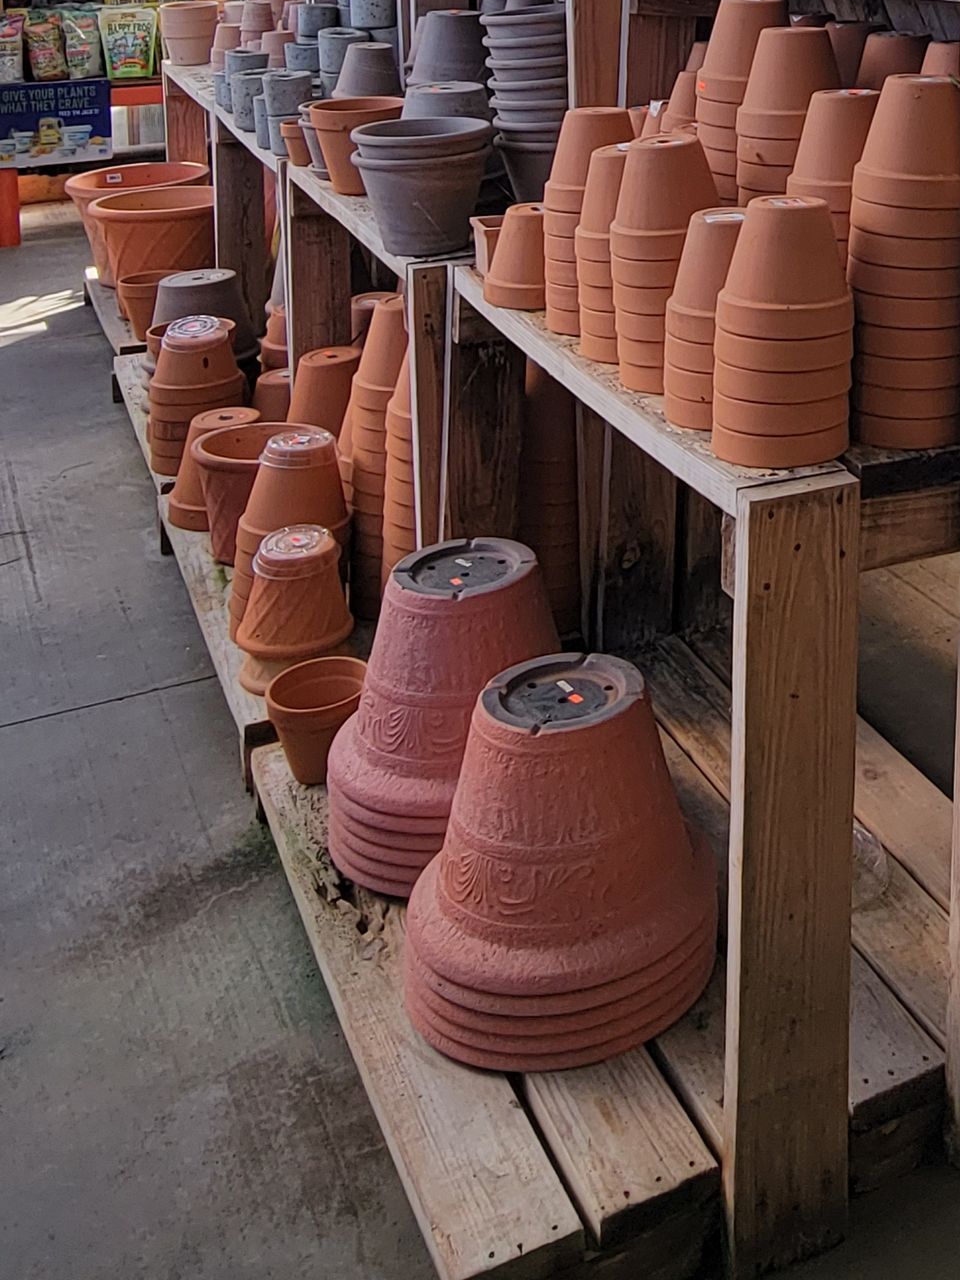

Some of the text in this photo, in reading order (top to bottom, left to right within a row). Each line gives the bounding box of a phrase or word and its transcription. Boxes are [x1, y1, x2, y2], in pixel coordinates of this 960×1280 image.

[2, 86, 97, 103] GIVE YOUR PLANTS
[0, 102, 29, 114] WHAT
[30, 99, 56, 112] THEY
